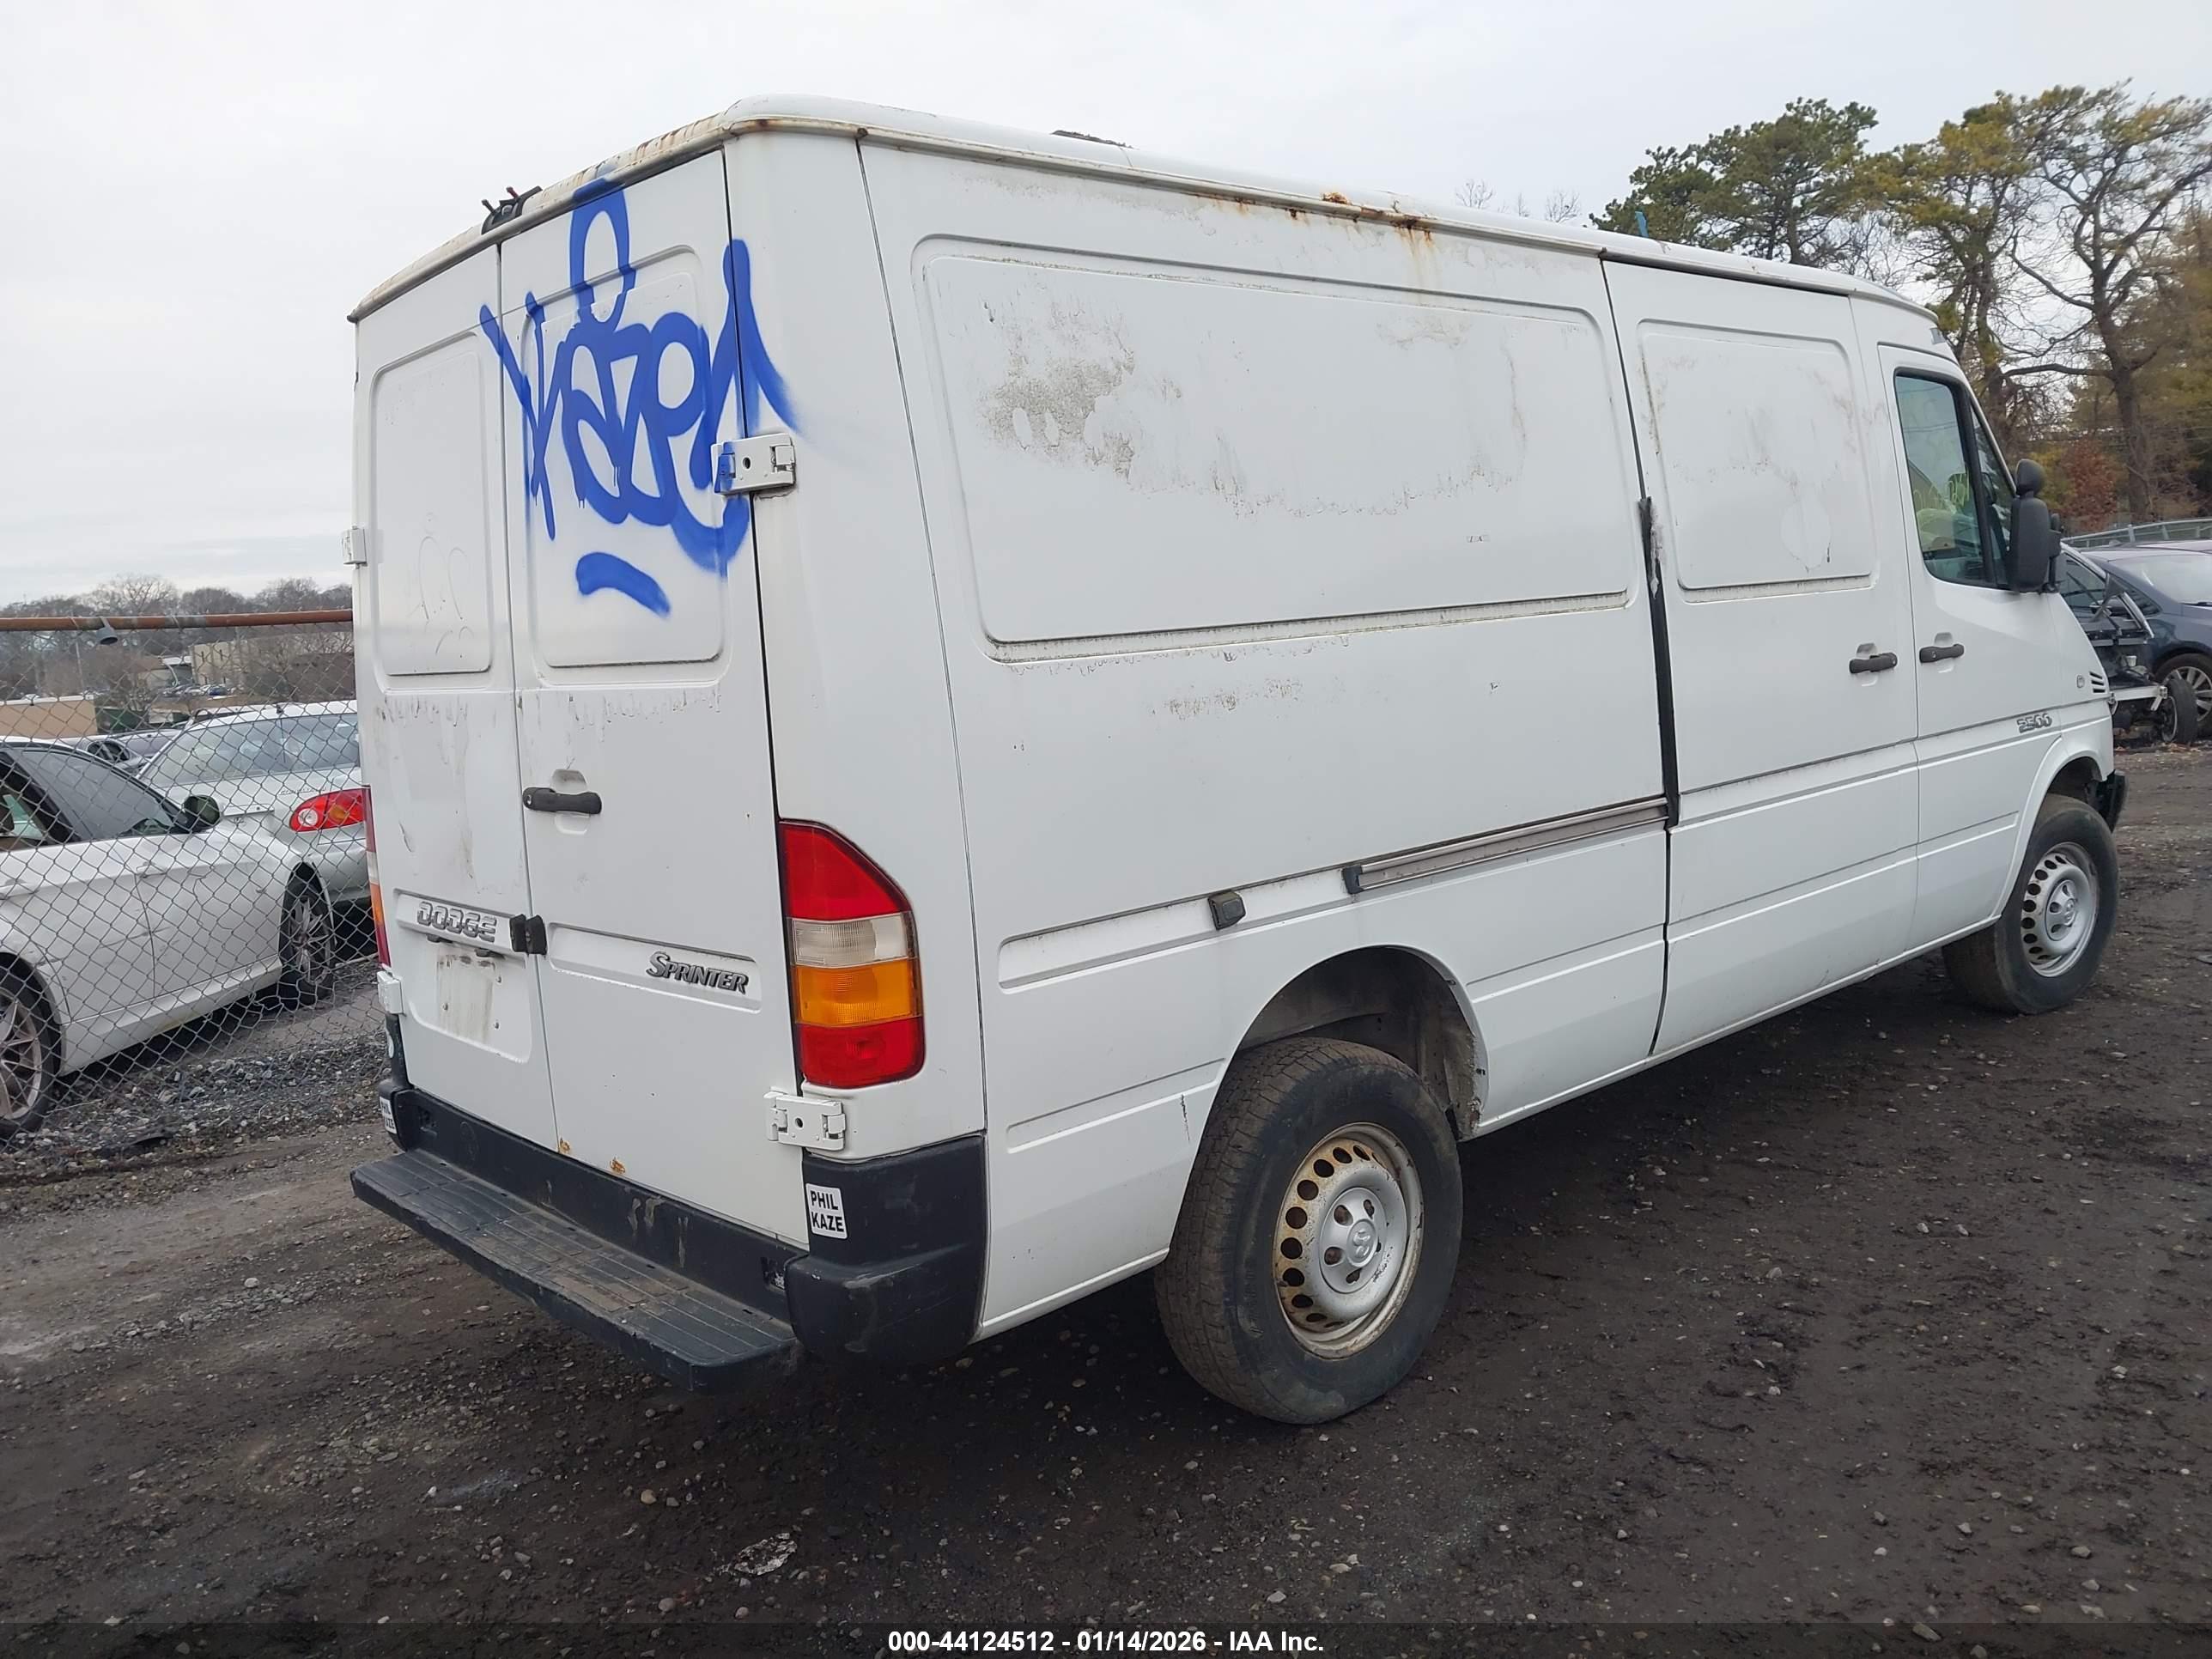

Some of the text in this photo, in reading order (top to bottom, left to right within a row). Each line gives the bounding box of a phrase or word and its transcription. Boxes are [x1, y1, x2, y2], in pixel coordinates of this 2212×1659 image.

[2016, 713, 2053, 733] 2500
[416, 901, 497, 943] DODGE
[810, 1189, 839, 1210] PHIL
[811, 1211, 844, 1232] KAZE
